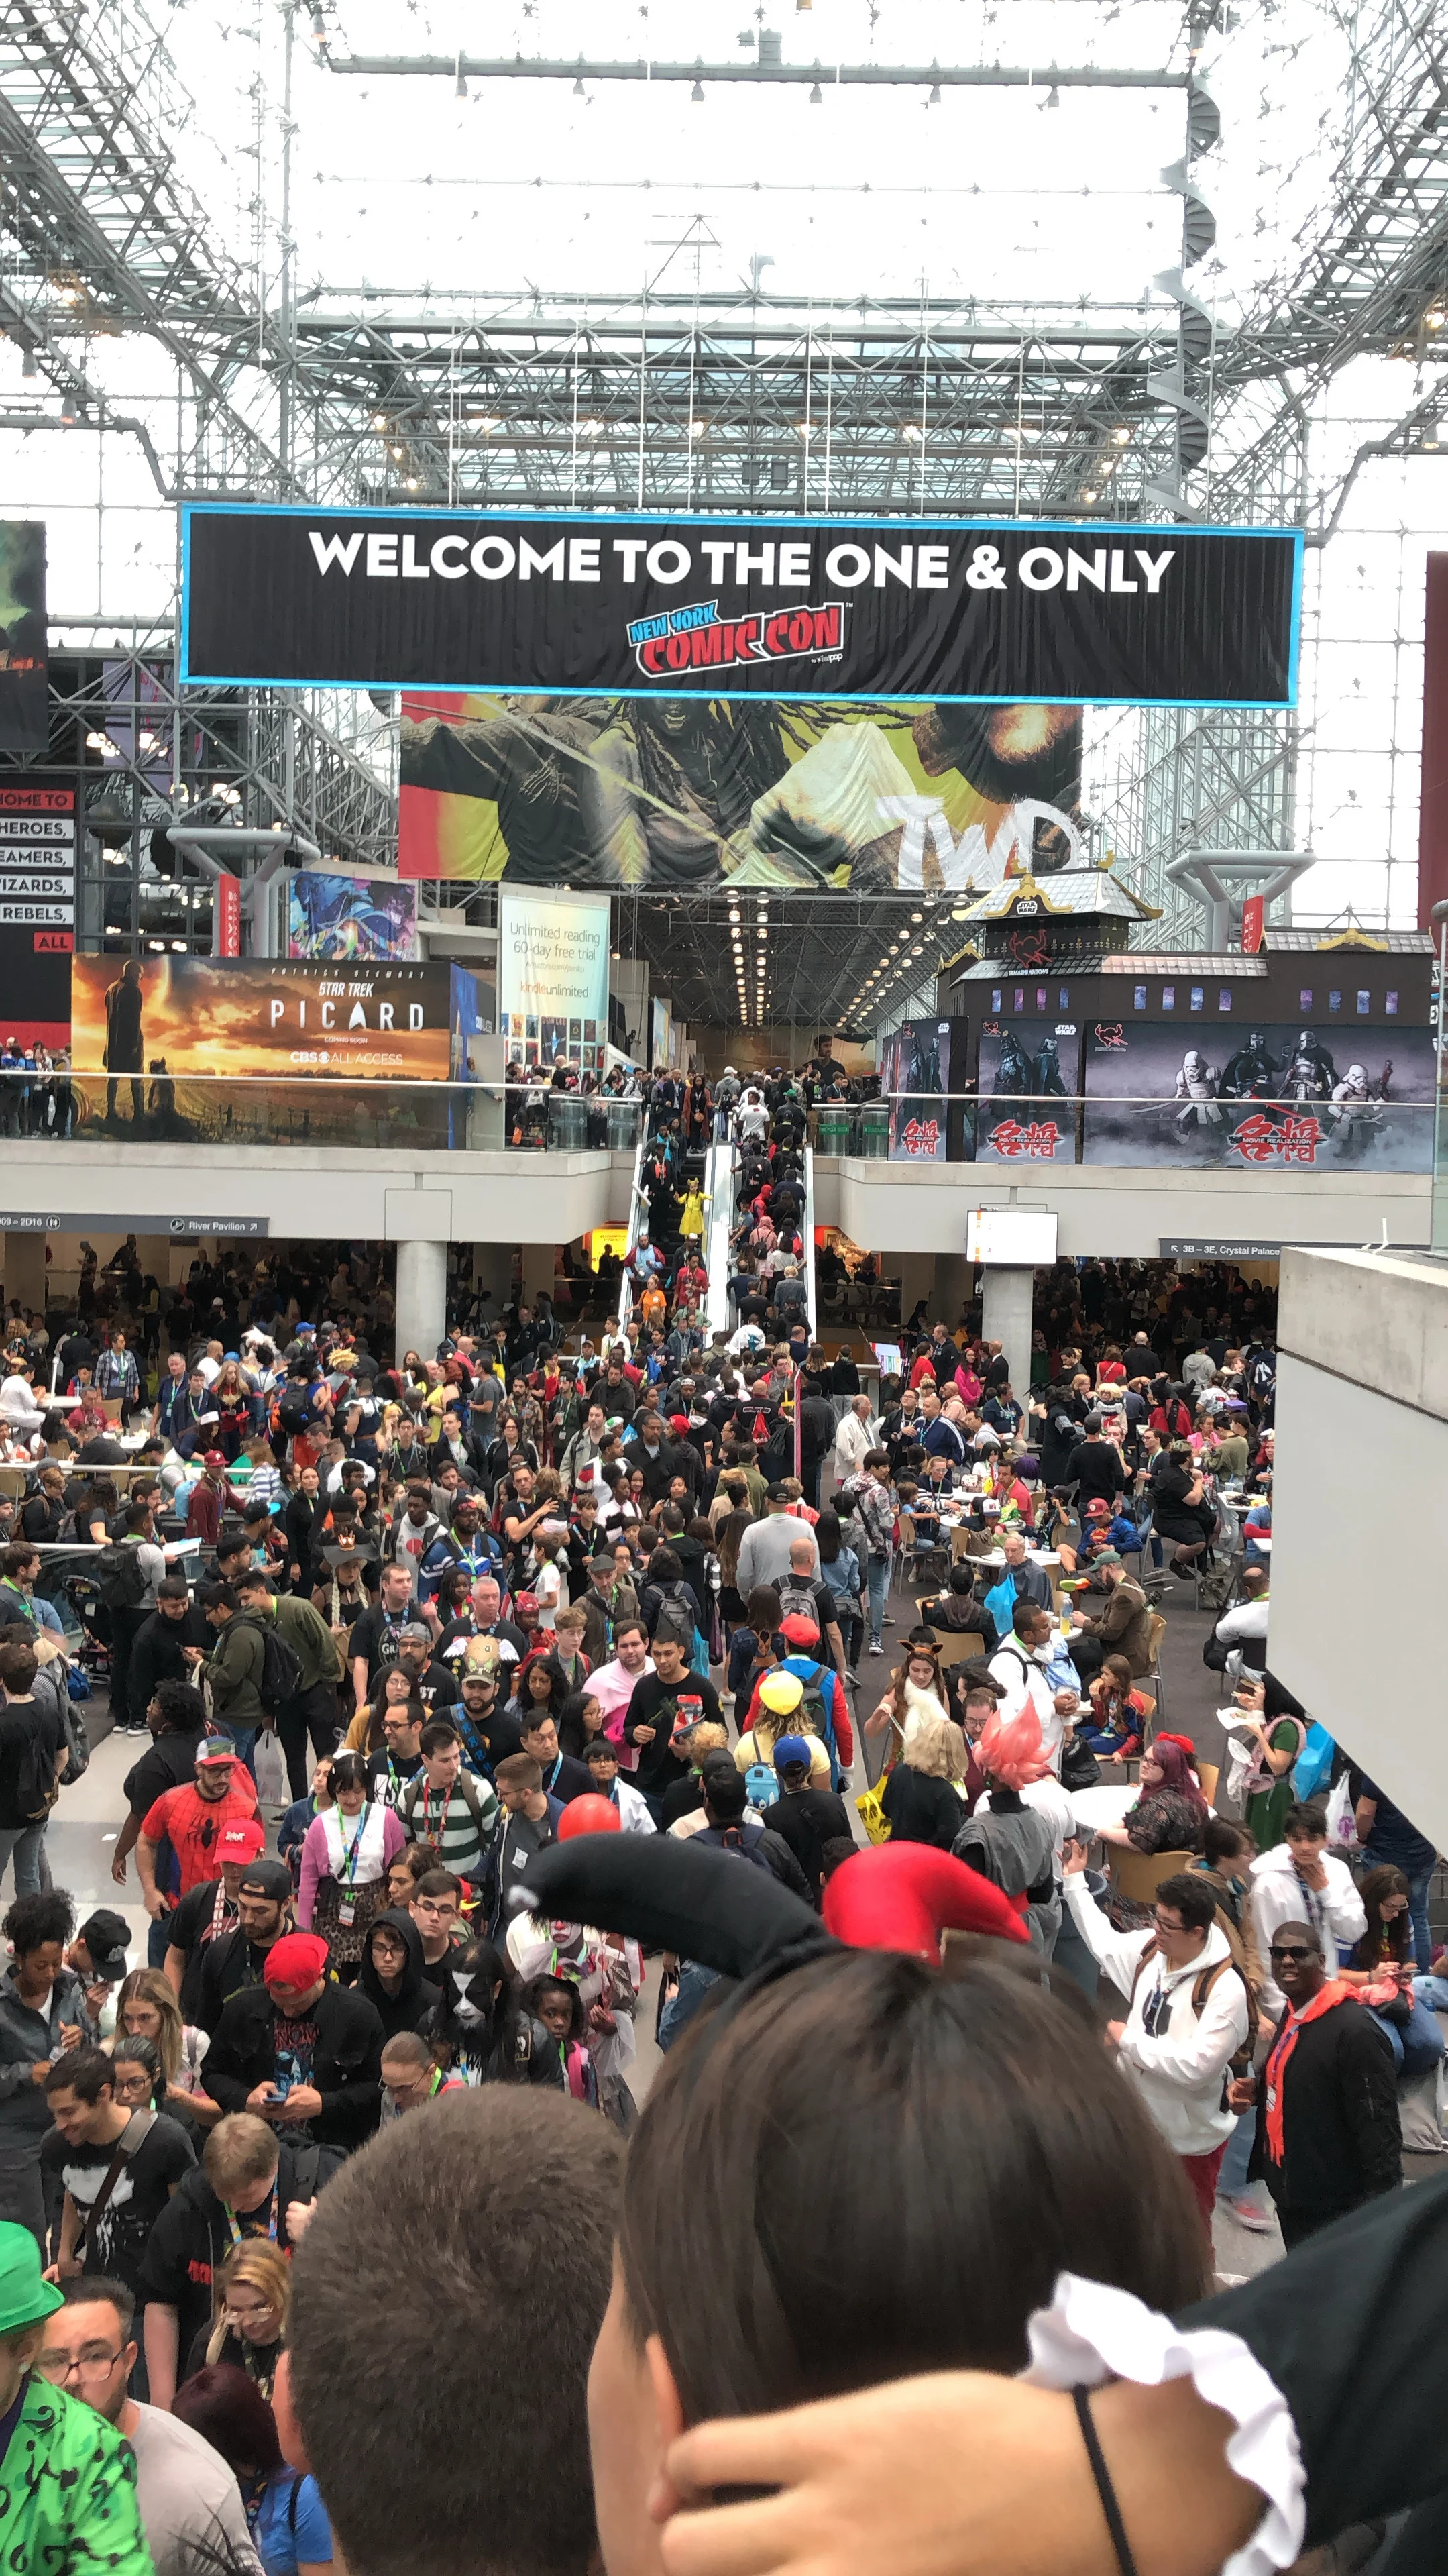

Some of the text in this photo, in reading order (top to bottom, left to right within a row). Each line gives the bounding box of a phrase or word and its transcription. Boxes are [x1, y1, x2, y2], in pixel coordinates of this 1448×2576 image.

[308, 531, 1176, 593] WELCOME TO THE ONE & ONLY
[630, 603, 718, 643] NEW YORK
[643, 619, 757, 672] COMIC
[765, 608, 838, 654] CON
[45, 794, 68, 806] TO
[0, 879, 66, 894] IZARDS,
[3, 907, 66, 922] REBELS,
[38, 936, 69, 949] ALL
[510, 921, 601, 948] Unlimited reading
[514, 940, 596, 961] 60-day free trial
[319, 981, 374, 998] STAR TREK
[520, 980, 589, 998] kindleunlimited
[270, 999, 424, 1031] PICARD
[290, 1051, 403, 1065] CBS ALL ACCESS
[188, 1220, 245, 1232] River Pavilion
[1182, 1245, 1194, 1253] 3B
[1203, 1246, 1217, 1255] 3E,
[1219, 1246, 1249, 1256] Crystal
[1251, 1247, 1280, 1256] Palace
